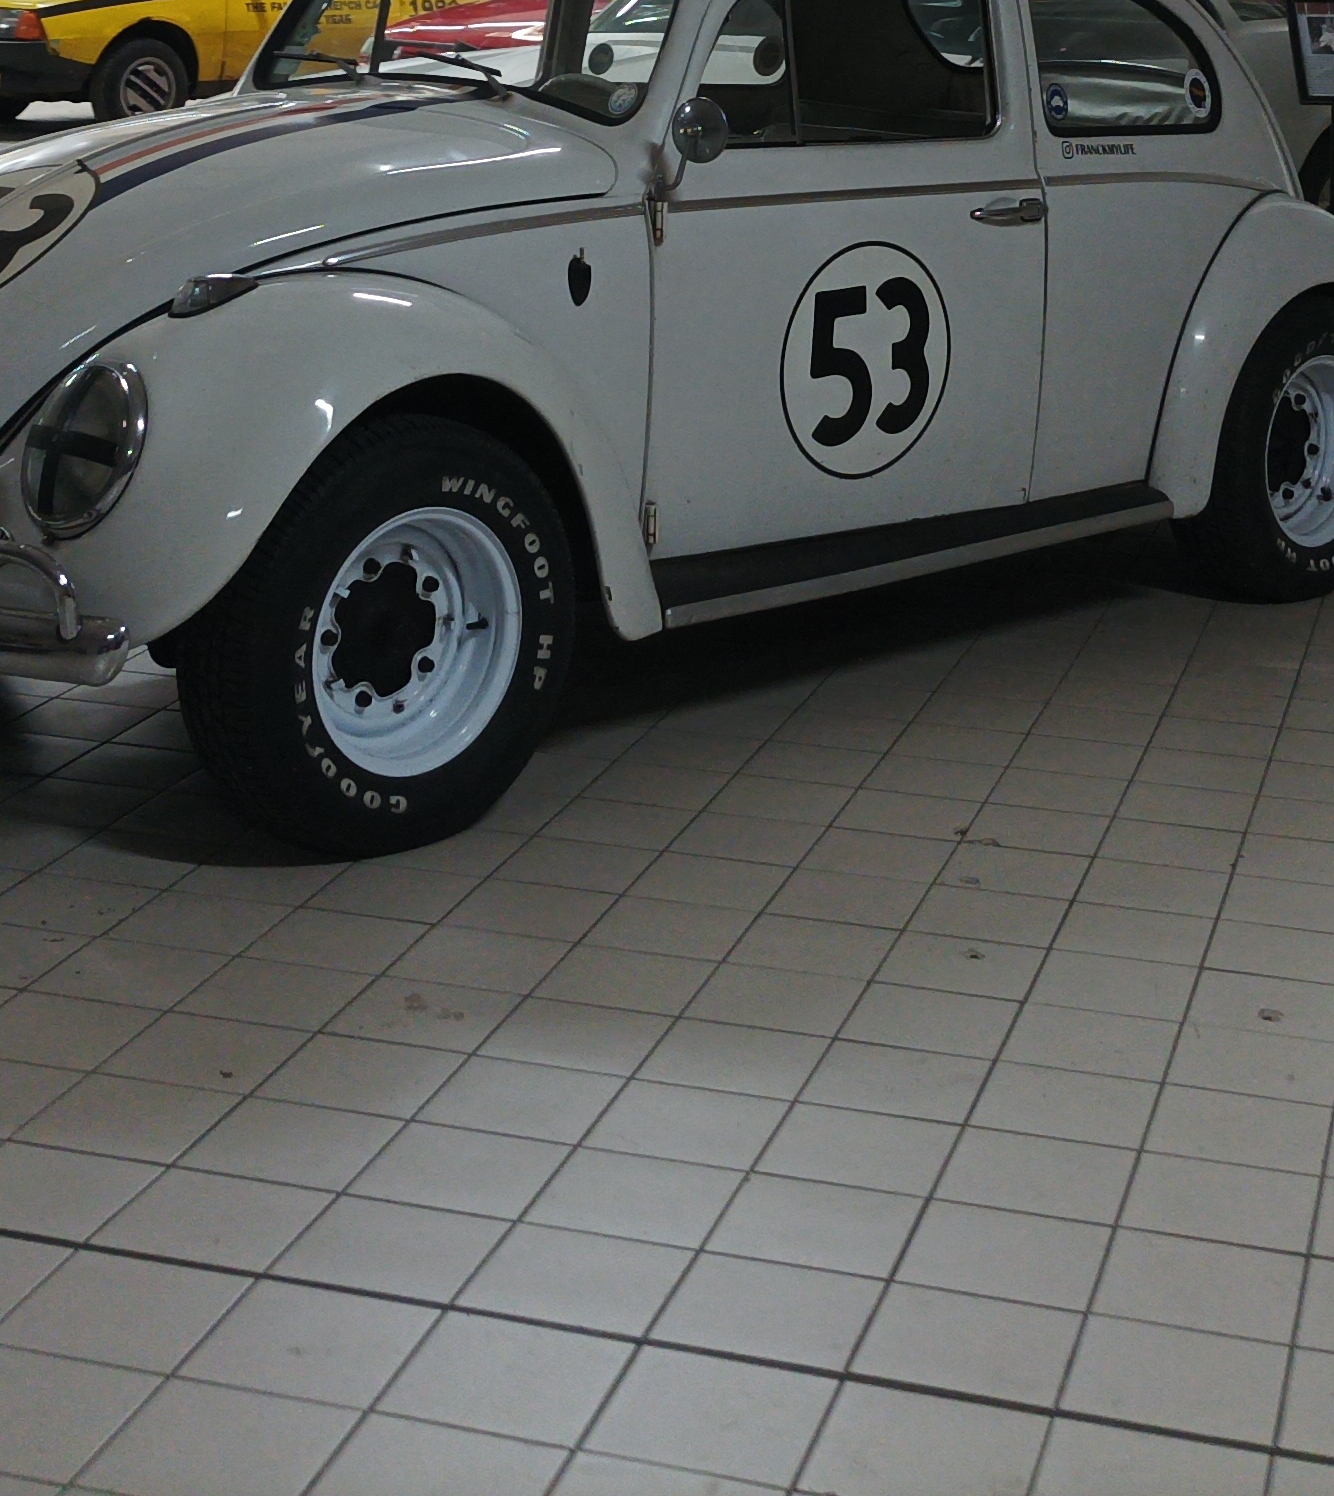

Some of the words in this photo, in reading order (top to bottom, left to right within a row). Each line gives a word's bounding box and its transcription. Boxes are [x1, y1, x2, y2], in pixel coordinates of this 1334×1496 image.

[810, 276, 930, 447] 53
[441, 475, 555, 604] WINGFOOT
[532, 634, 554, 691] HP
[294, 606, 408, 815] GOODYEAR
